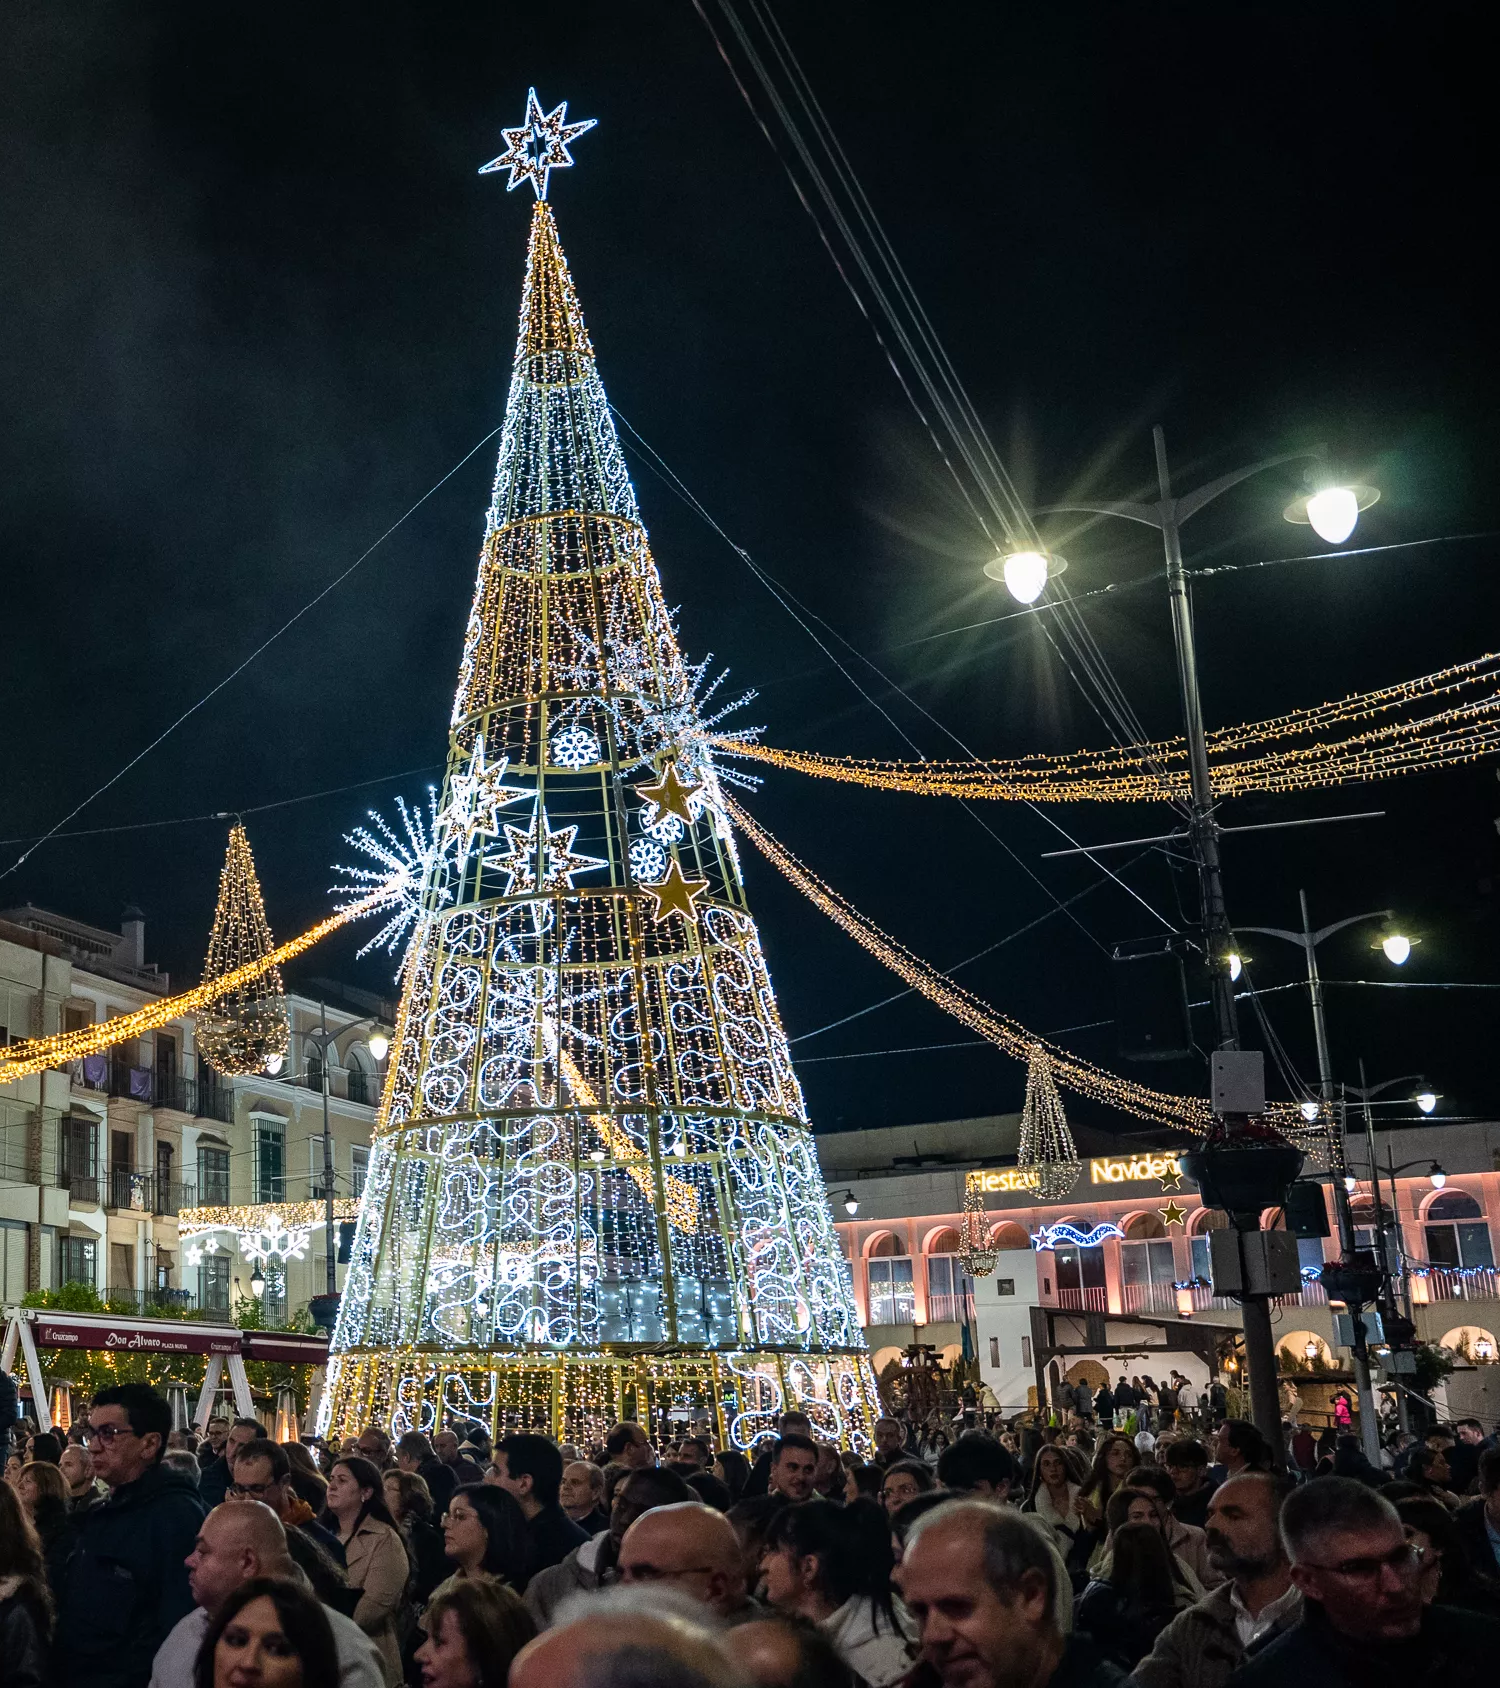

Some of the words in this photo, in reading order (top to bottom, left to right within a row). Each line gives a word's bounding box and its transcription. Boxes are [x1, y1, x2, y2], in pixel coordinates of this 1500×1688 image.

[52, 1332, 79, 1343] Cruzcampo
[105, 1332, 127, 1347] Don
[128, 1332, 161, 1348] Álvaro
[161, 1342, 174, 1350] PLAZA
